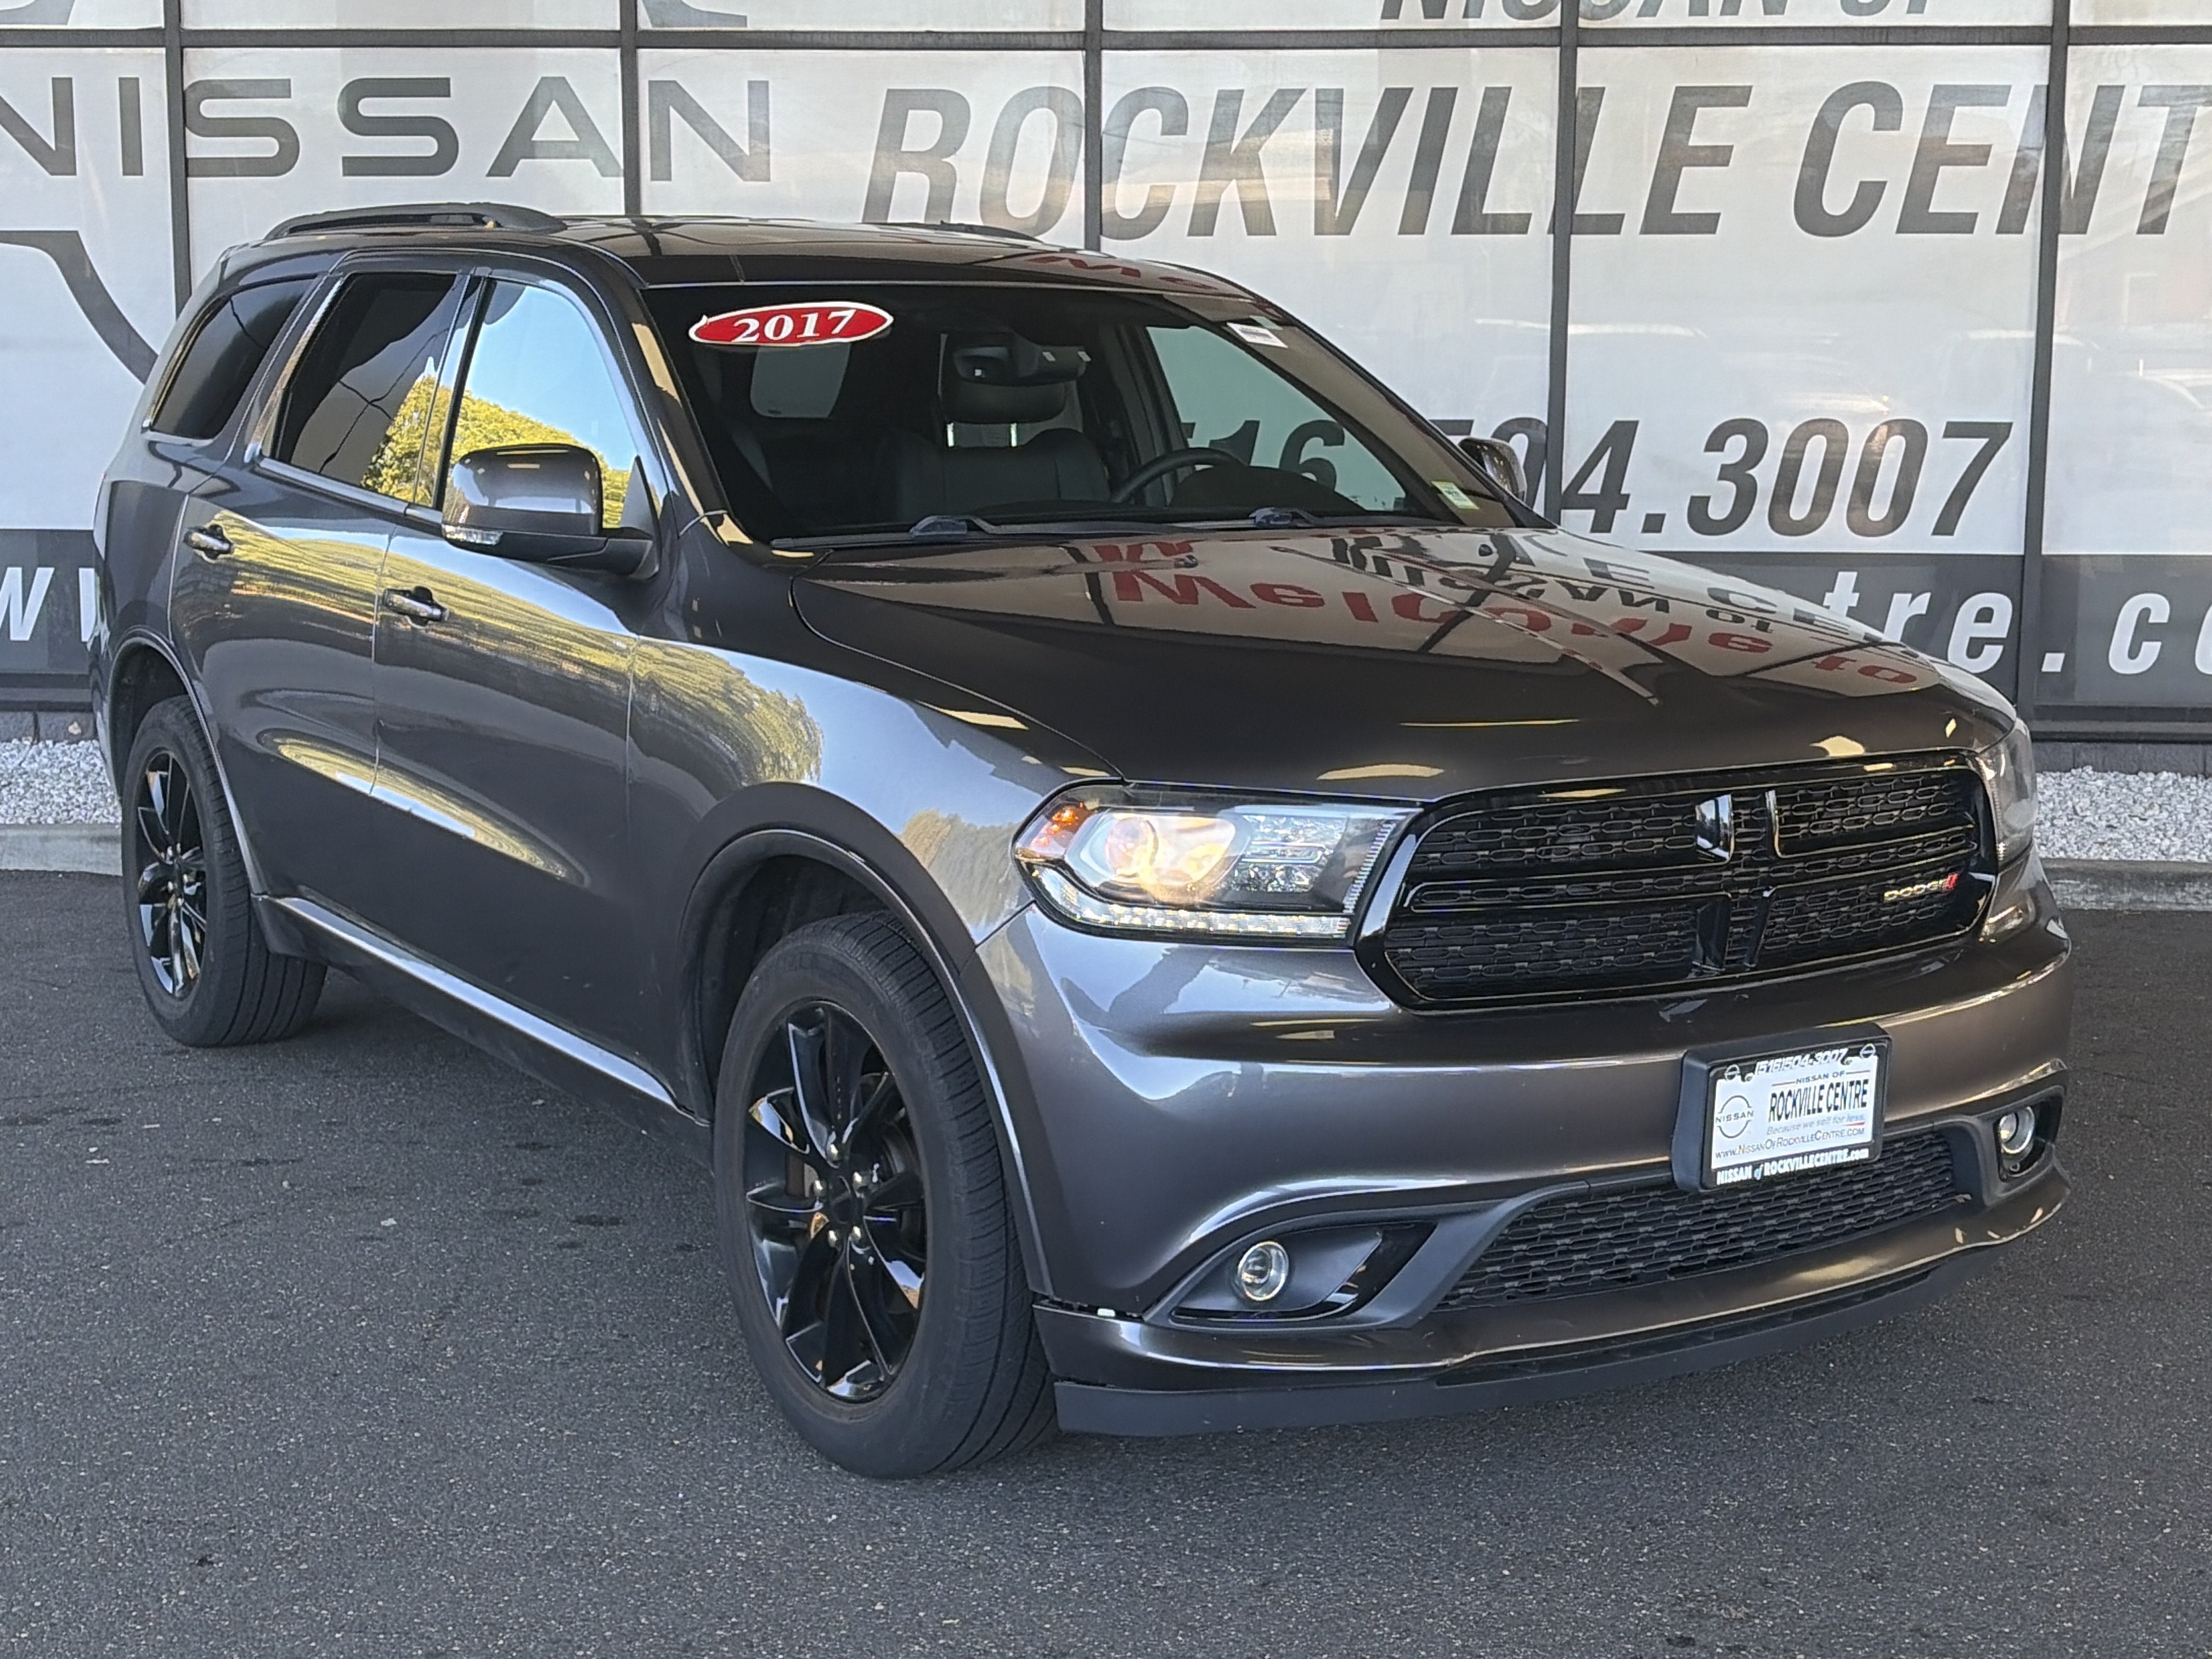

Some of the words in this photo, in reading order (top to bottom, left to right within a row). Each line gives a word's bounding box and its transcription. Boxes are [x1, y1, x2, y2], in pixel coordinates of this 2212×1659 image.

[0, 77, 771, 182] NISSAN
[862, 85, 1753, 240] ROCKVILLE
[732, 309, 857, 343] 2017
[1796, 1074, 1829, 1085] NISSAN
[1768, 1084, 1825, 1122] ROCKVILLE
[1826, 1079, 1870, 1113] CENTRE
[1716, 1110, 1754, 1124] NISSAN
[1767, 1124, 1801, 1136] Because
[1833, 1115, 1846, 1124] for
[1716, 1165, 1753, 1186] NISSAN
